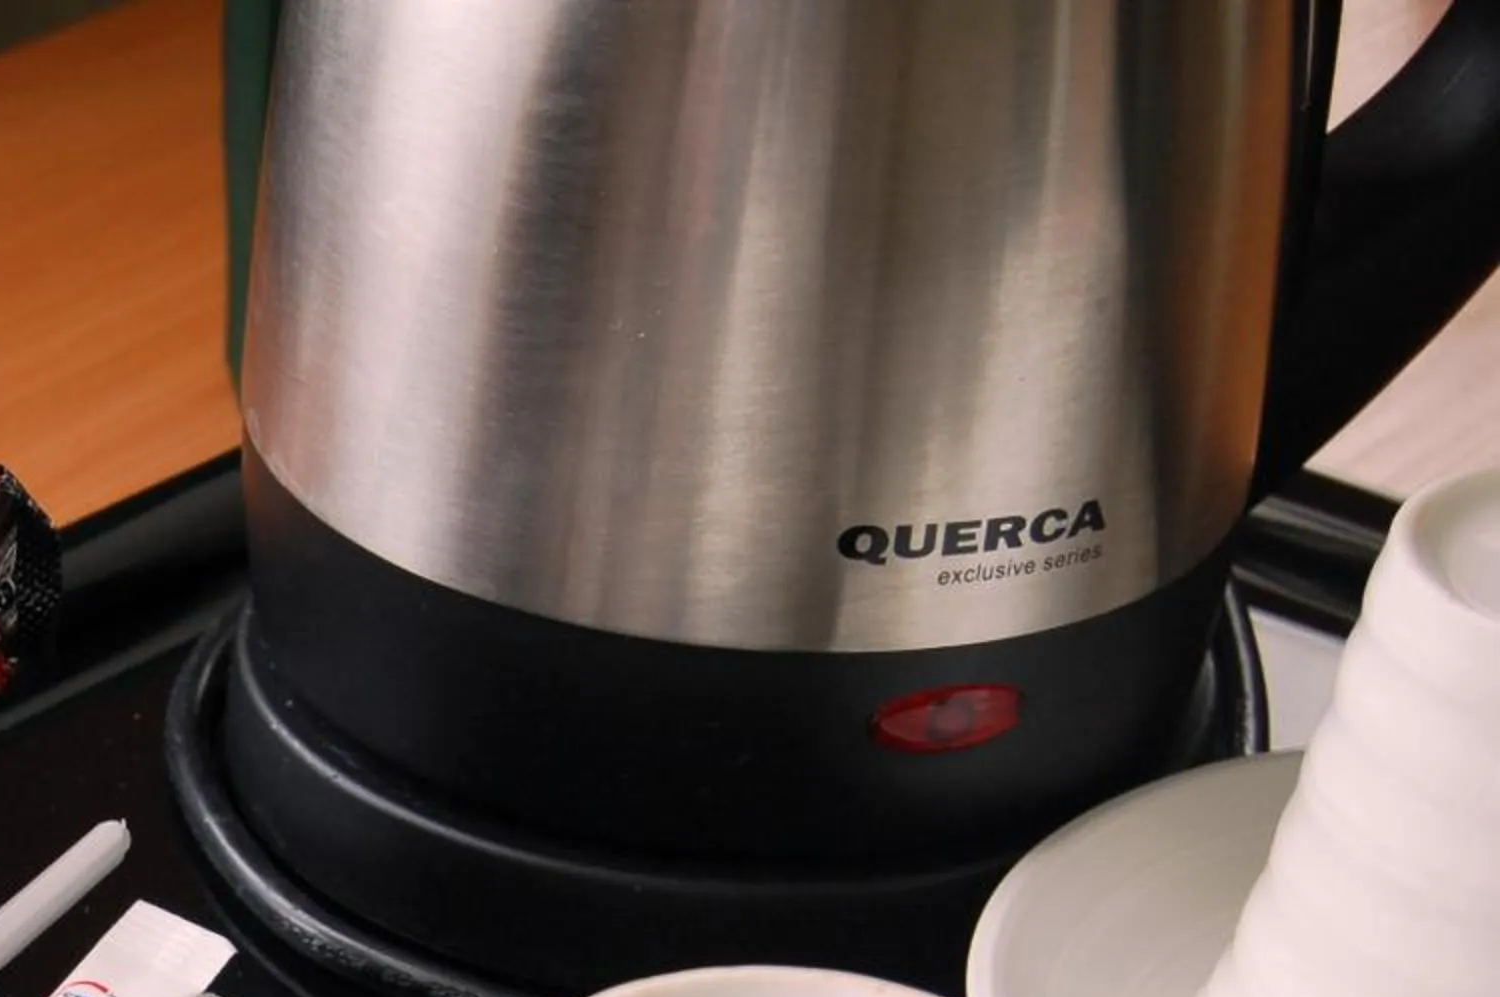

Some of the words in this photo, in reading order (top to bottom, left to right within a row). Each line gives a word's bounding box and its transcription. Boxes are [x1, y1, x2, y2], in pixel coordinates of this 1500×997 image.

[837, 499, 1106, 565] QUERCA
[937, 557, 1036, 586] exclusive
[1042, 544, 1104, 572] series
